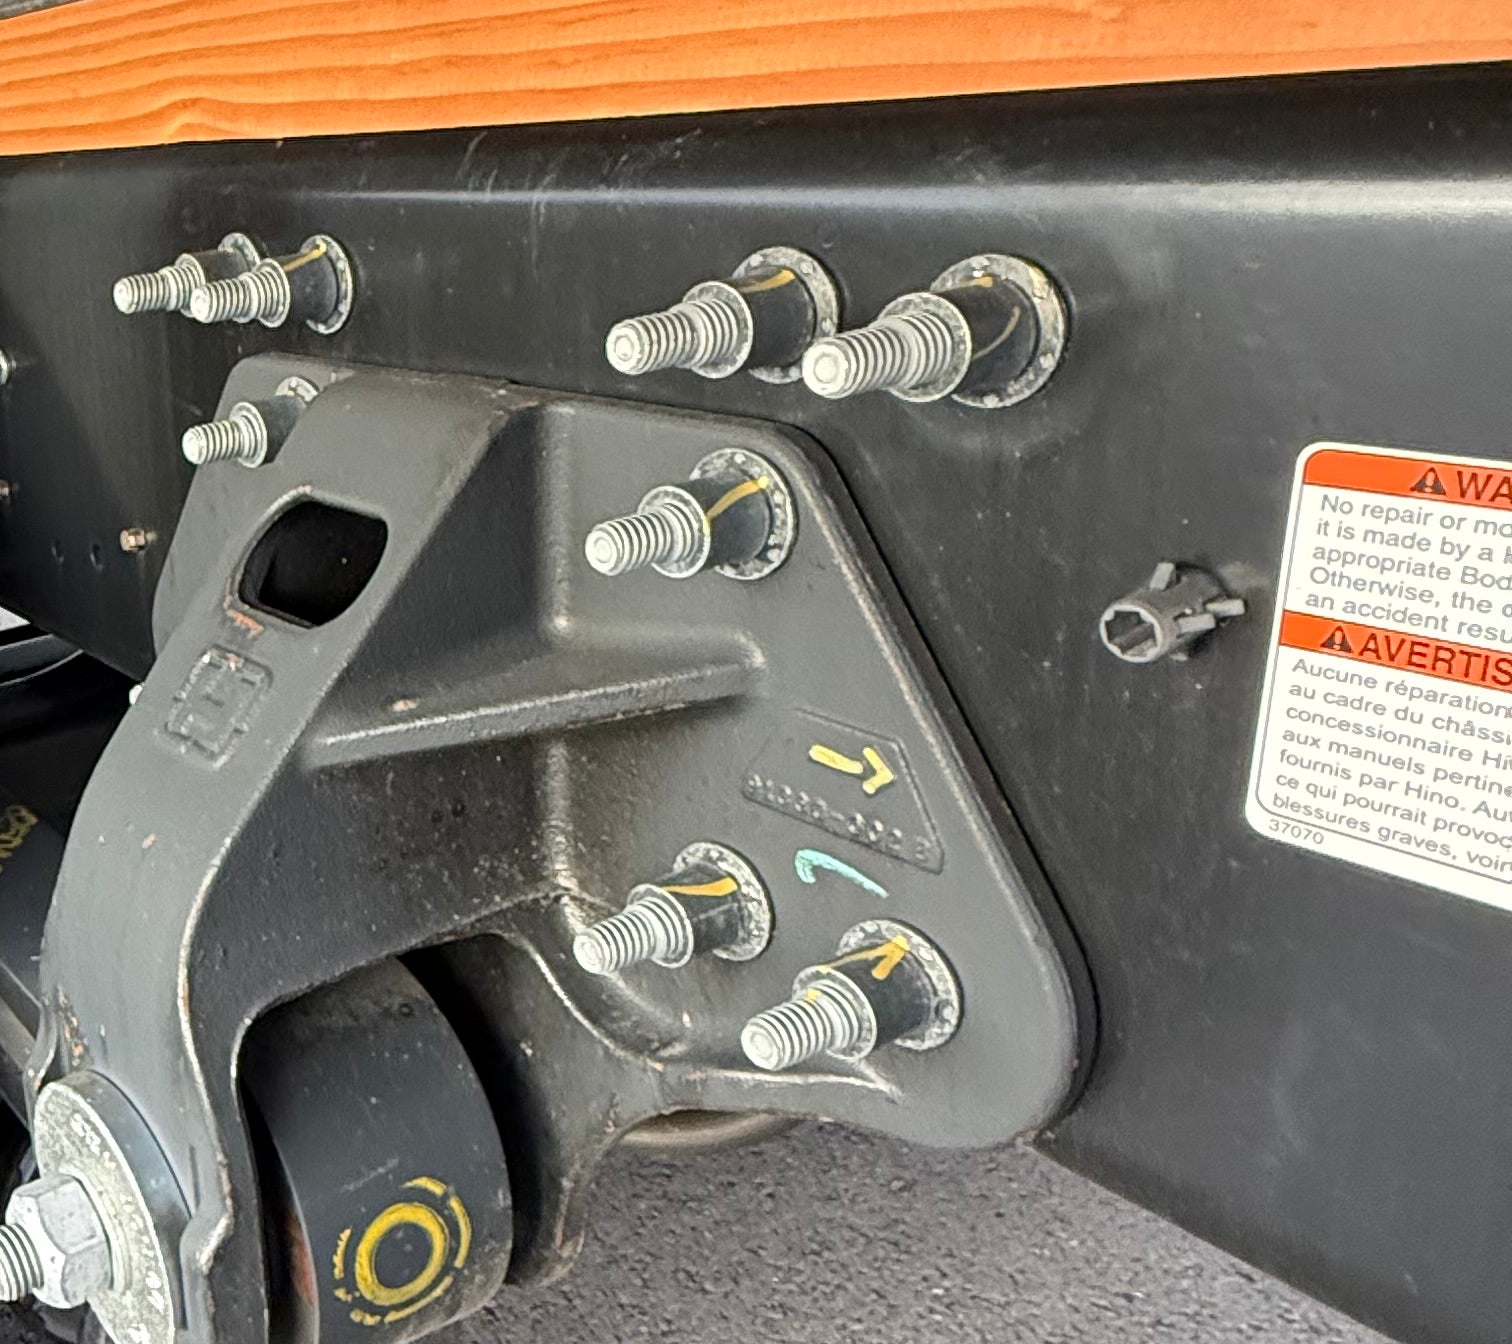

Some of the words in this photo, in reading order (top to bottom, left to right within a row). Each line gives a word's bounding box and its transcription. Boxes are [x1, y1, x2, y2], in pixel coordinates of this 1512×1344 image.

[1321, 494, 1353, 515] No
[1361, 503, 1433, 526] repair
[1439, 515, 1467, 531] or
[1316, 518, 1329, 536] it
[1337, 520, 1355, 540] is
[1363, 529, 1431, 552] made
[1440, 536, 1470, 562] by
[1477, 547, 1494, 562] a
[1312, 546, 1451, 581] appropriate
[1309, 566, 1440, 608] Otherwise,
[1451, 591, 1493, 614] the
[1305, 593, 1335, 610] an
[1342, 599, 1449, 633] accident
[1292, 658, 1378, 689] Aucune
[1357, 632, 1512, 687] AVERTIS
[1288, 684, 1316, 700] au
[1323, 691, 1387, 716] cadre
[1393, 705, 1424, 725] du
[1282, 729, 1321, 749] aux
[1328, 740, 1425, 775] manuels
[1285, 706, 1474, 762] concessionnaire
[1276, 773, 1300, 790] ce
[1305, 781, 1337, 800] qui
[1343, 792, 1427, 827] pourrait
[1279, 748, 1352, 781] fournis
[1358, 772, 1399, 793] par
[1404, 780, 1466, 812] Hino.
[1268, 817, 1325, 846] 37070
[1272, 792, 1370, 834] blessures
